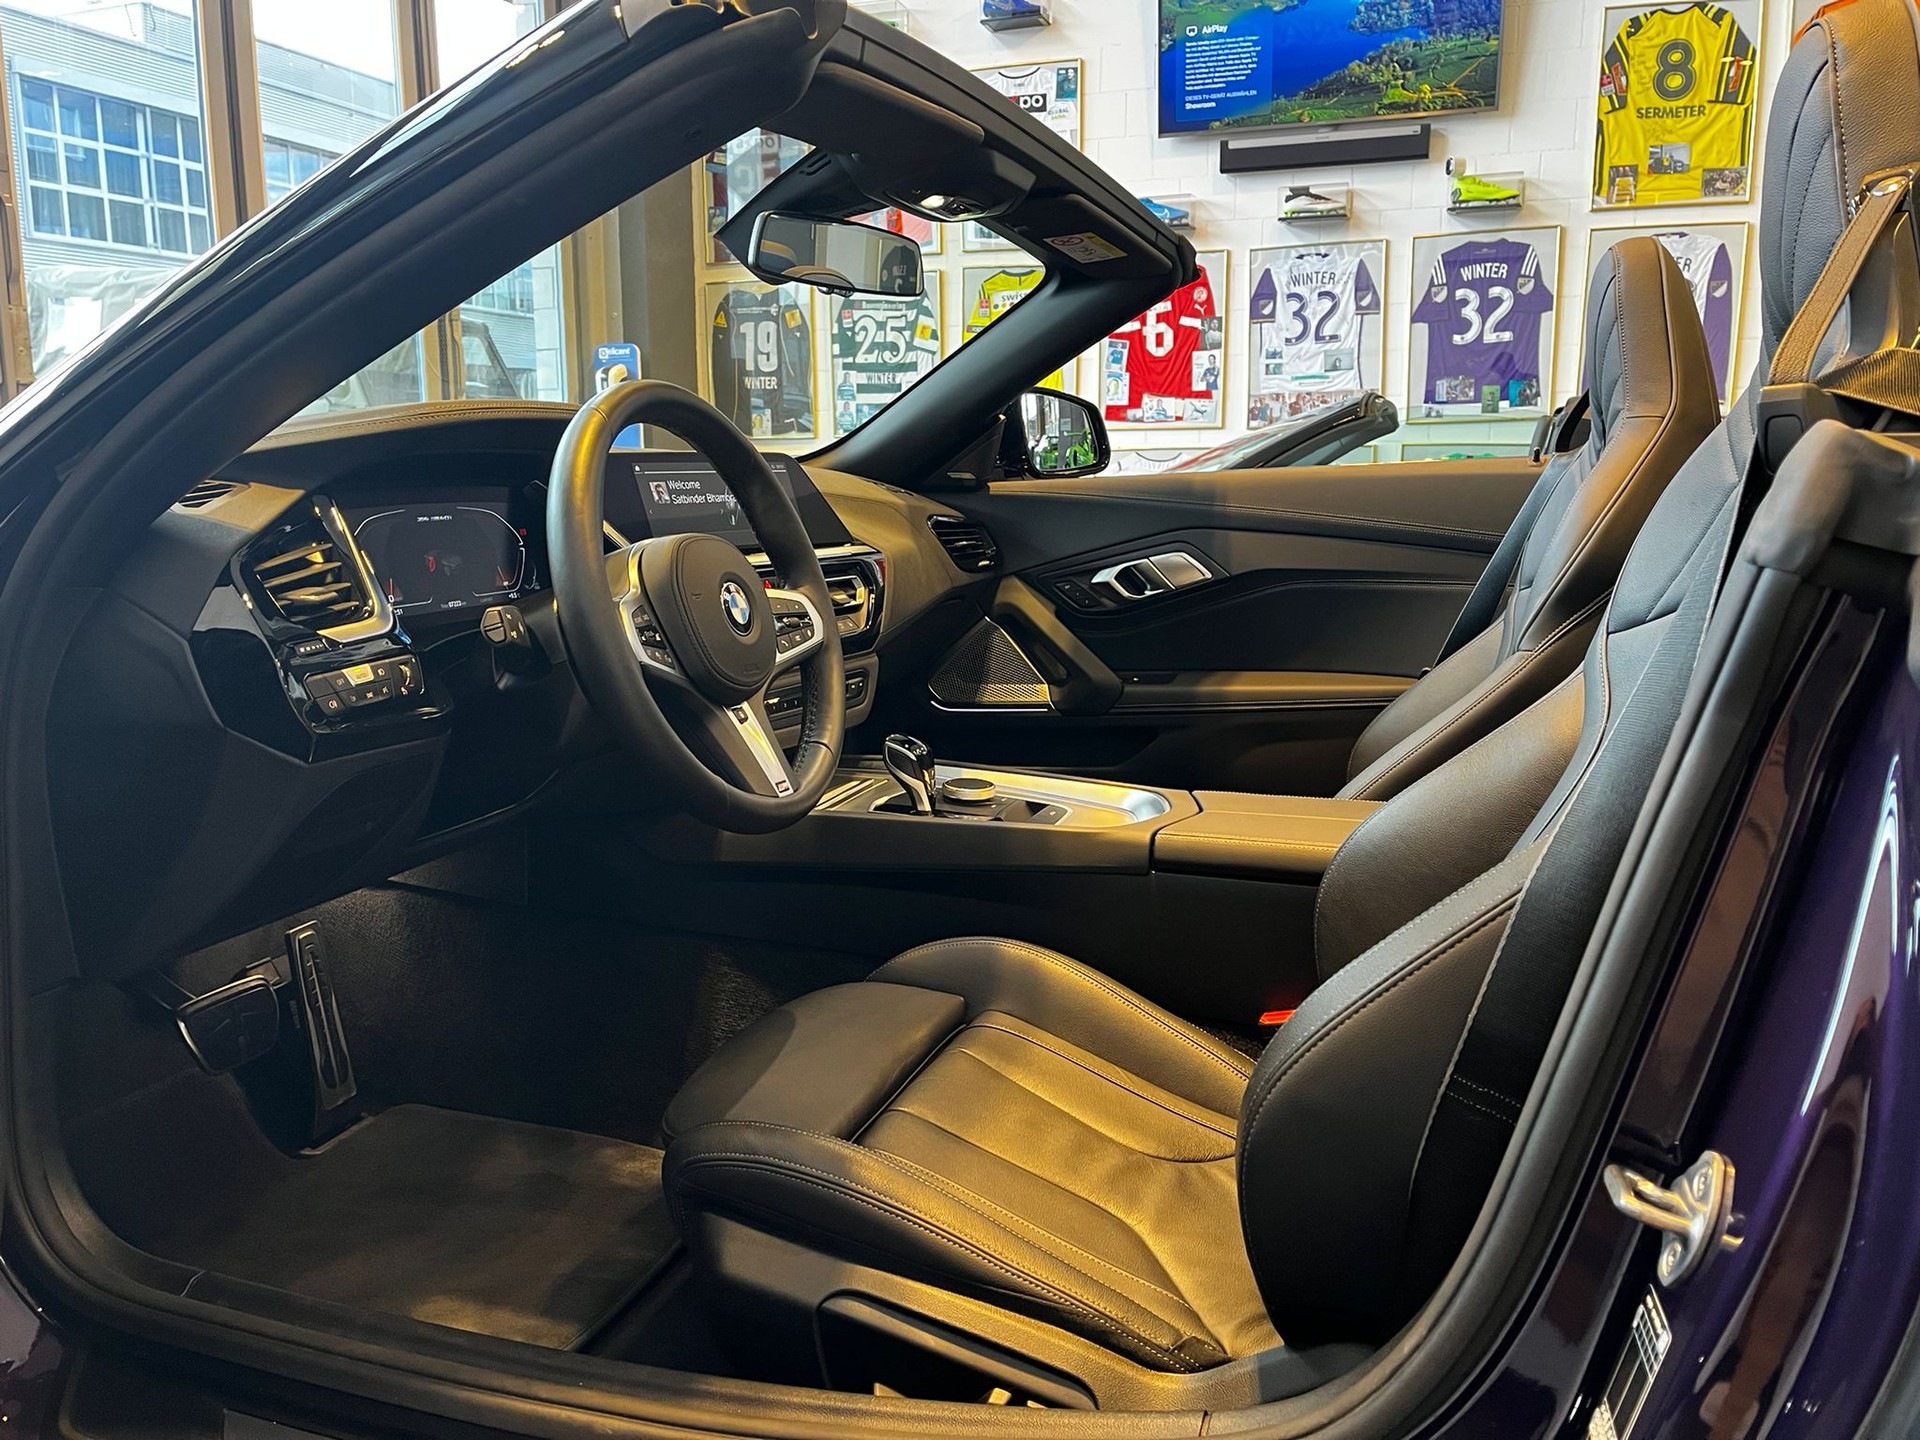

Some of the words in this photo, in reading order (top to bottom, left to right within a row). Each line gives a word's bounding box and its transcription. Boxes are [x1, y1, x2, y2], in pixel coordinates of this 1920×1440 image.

[1202, 24, 1228, 34] AirPlay
[1653, 38, 1697, 101] 8
[1185, 102, 1216, 110] Showroom
[1636, 105, 1706, 119] SERMETER
[1290, 271, 1337, 287] WINTER
[1460, 263, 1509, 281] WINTER
[1284, 290, 1342, 346] 32
[1452, 286, 1515, 346] 32
[1142, 300, 1175, 357] 6
[740, 321, 778, 372] 19
[854, 315, 907, 364] 25
[743, 376, 778, 390] WINTER
[867, 372, 897, 384] WINTER
[667, 480, 701, 490] Welcome
[671, 494, 706, 505] Satbinder
